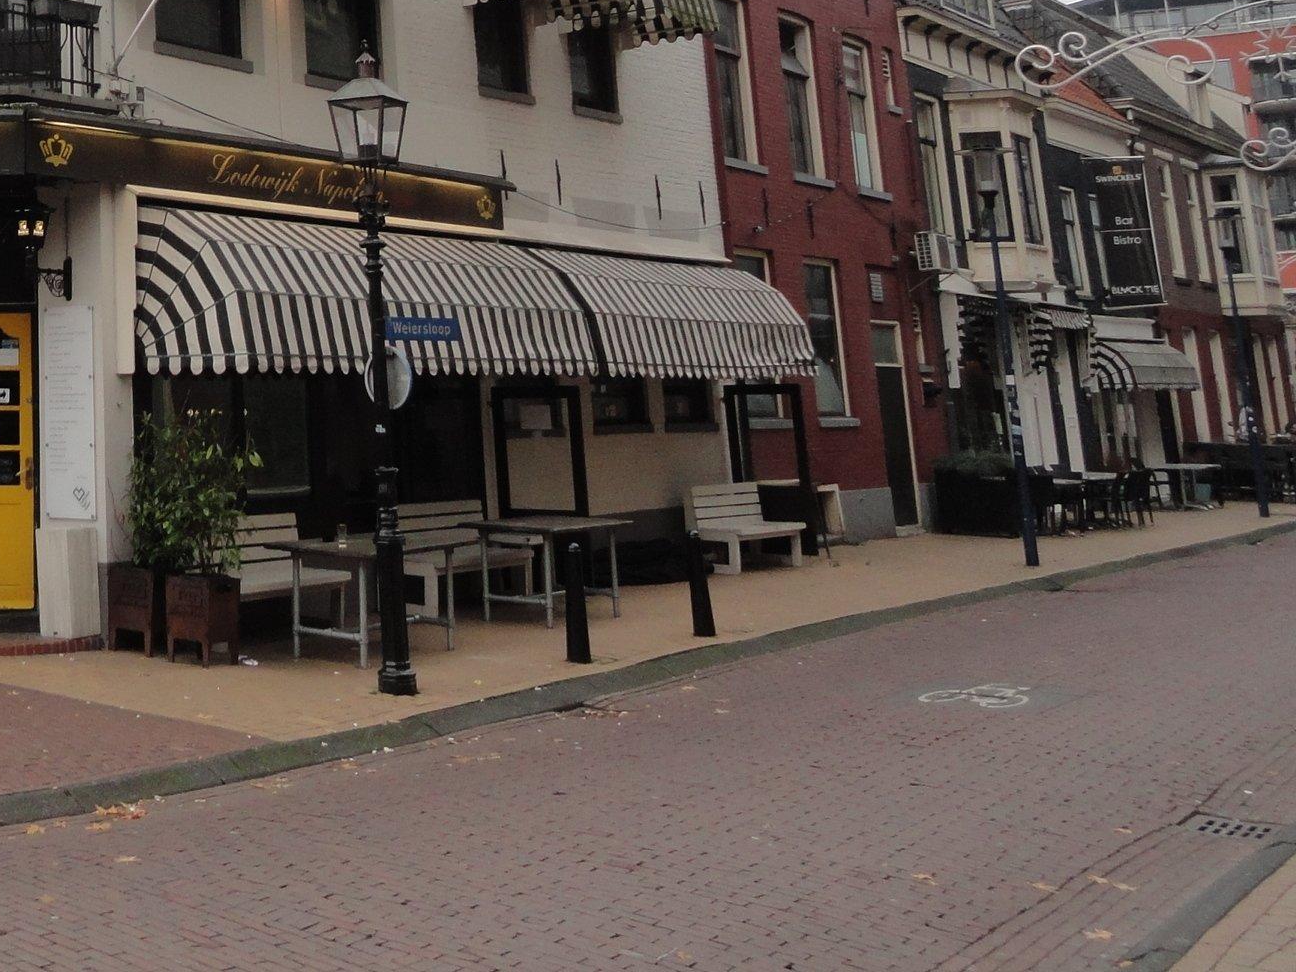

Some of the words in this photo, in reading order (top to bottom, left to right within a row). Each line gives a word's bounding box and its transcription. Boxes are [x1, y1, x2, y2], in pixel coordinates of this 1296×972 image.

[211, 154, 304, 199] Lodewijk
[1115, 216, 1133, 226] Bar
[1113, 235, 1142, 245] Bistro
